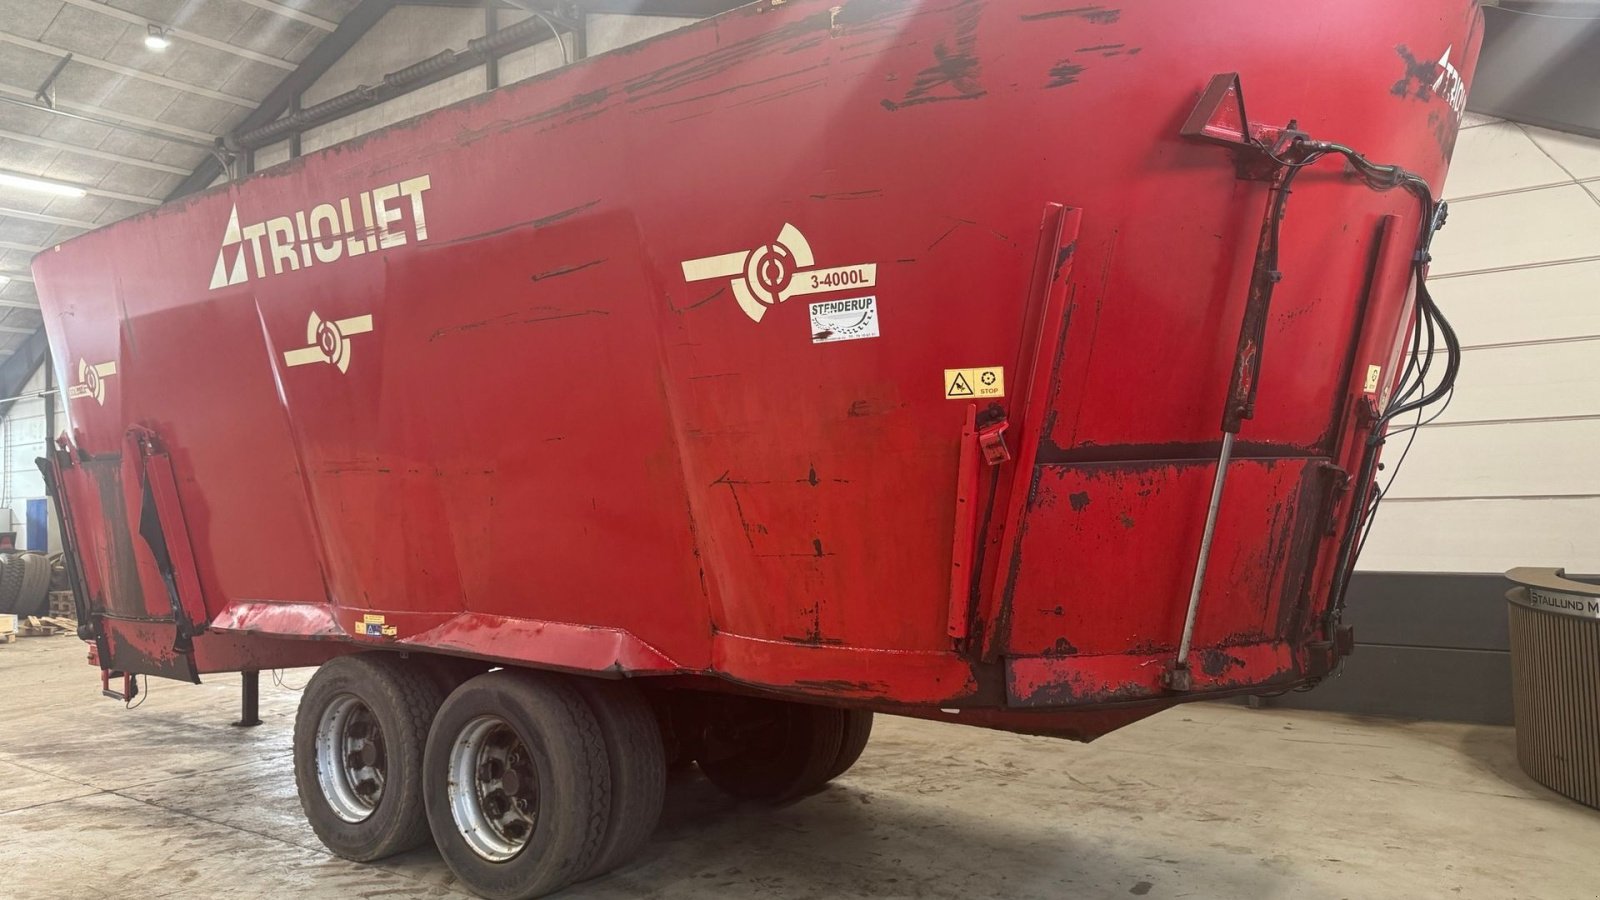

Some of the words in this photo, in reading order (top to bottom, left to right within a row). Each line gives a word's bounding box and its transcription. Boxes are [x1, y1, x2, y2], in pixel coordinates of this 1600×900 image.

[242, 174, 432, 279] TRIOLIET
[811, 269, 869, 289] 3-4000L
[811, 298, 873, 315] STENDERUP
[980, 387, 999, 395] STOP
[1531, 592, 1584, 611] STAULUND
